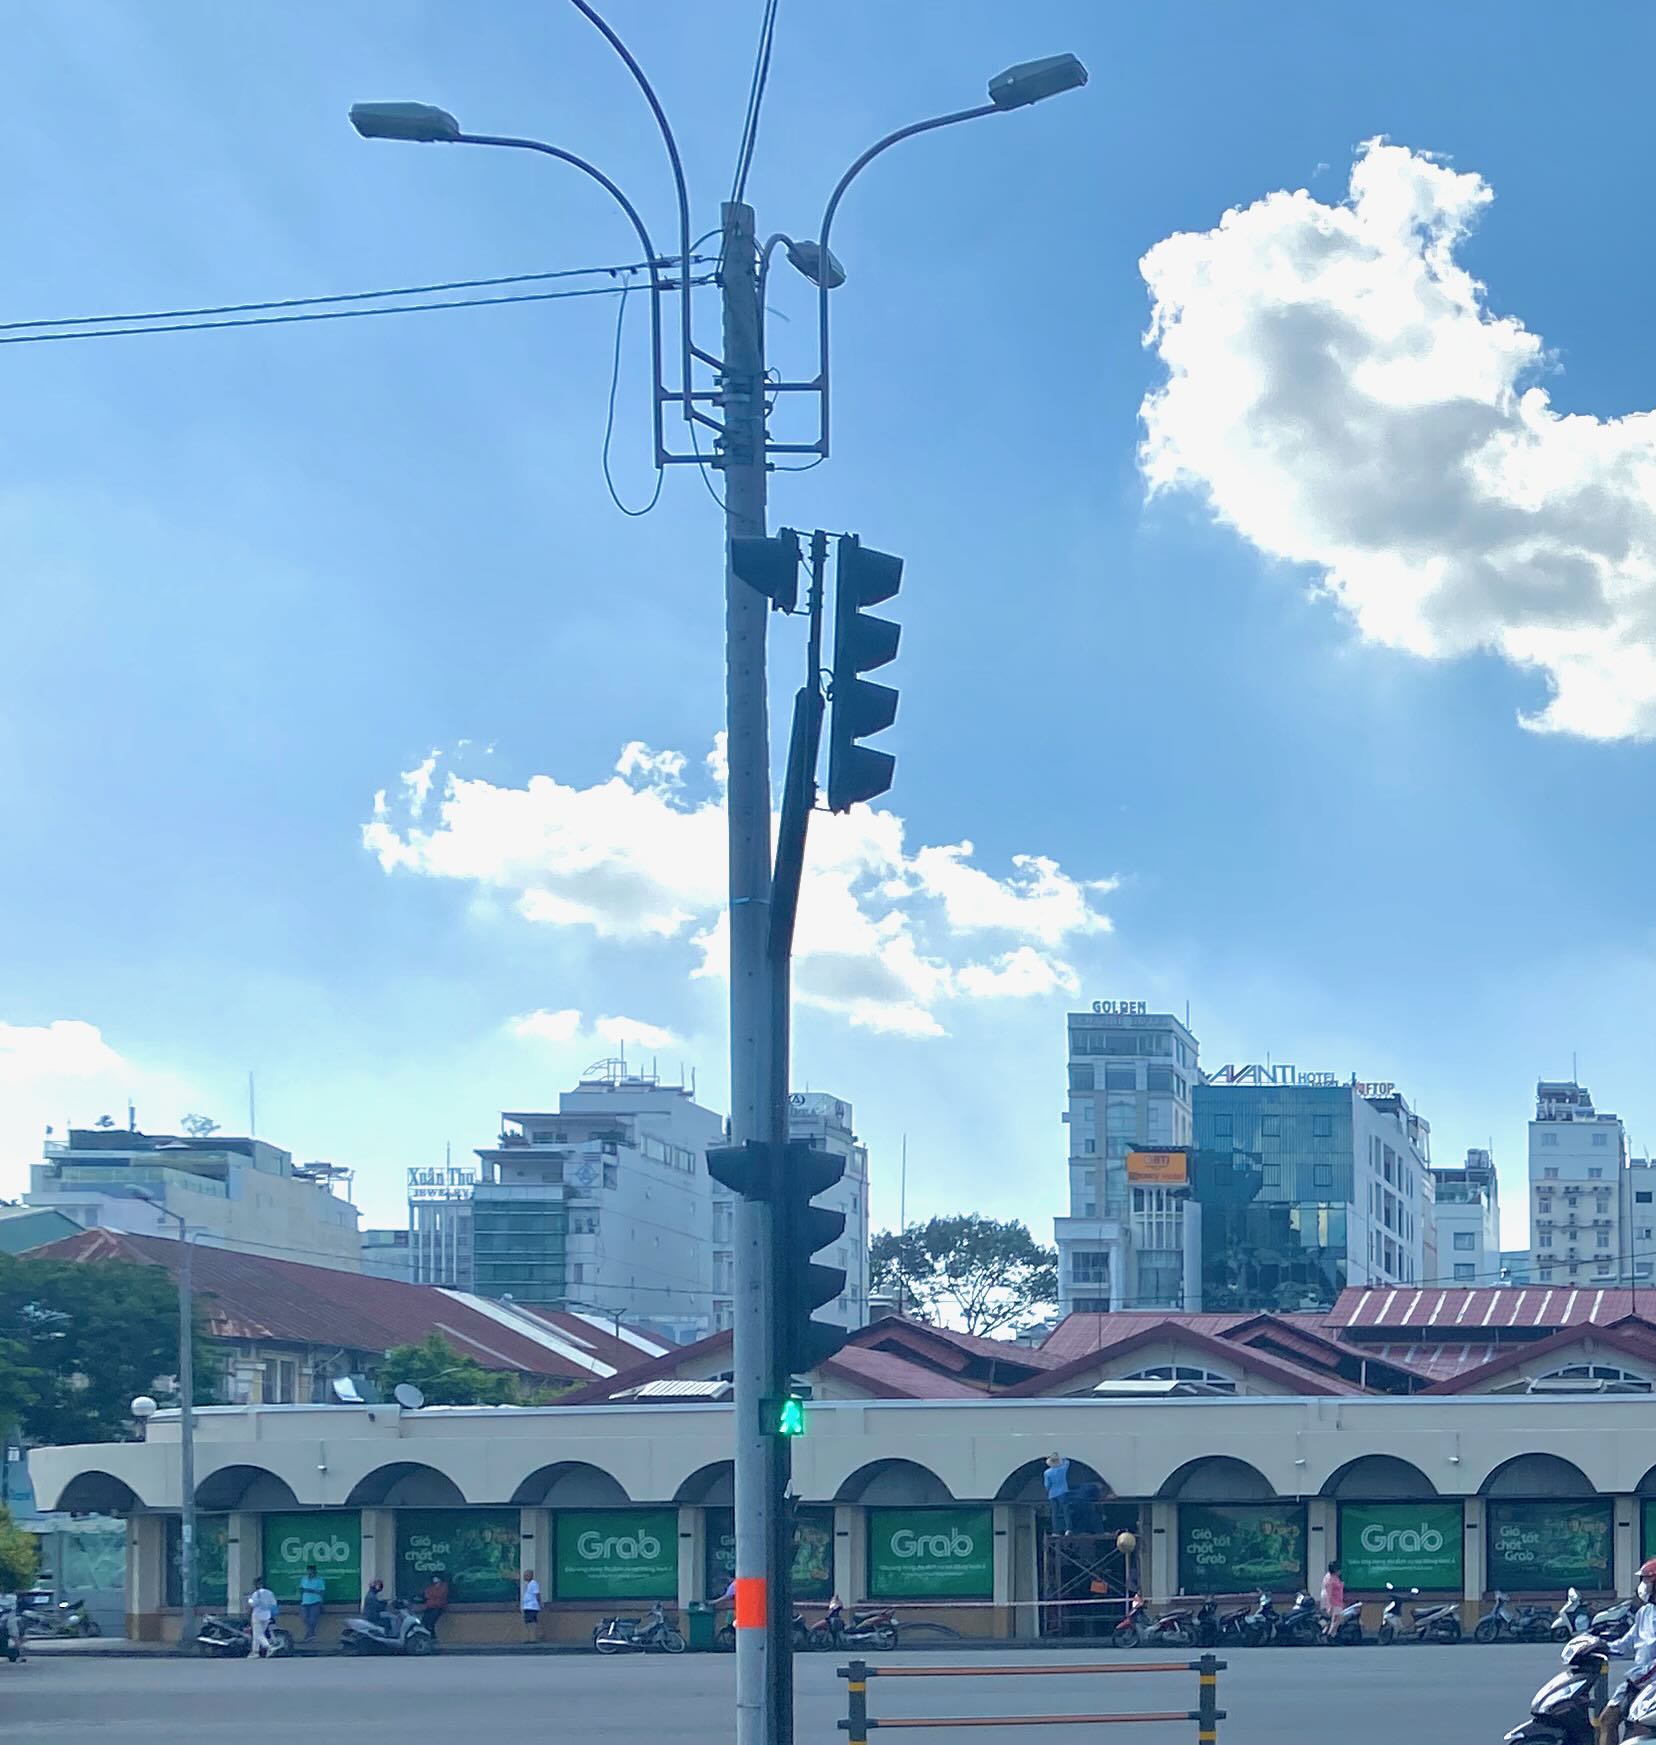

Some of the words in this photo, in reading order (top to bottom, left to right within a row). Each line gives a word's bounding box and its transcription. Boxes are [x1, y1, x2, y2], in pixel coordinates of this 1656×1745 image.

[1092, 1000, 1147, 1014] GOLDEN
[1210, 1064, 1296, 1083] AVANTI
[577, 1528, 661, 1560] Grab
[890, 1527, 974, 1558] Grab
[1360, 1522, 1444, 1553] Grab
[280, 1534, 350, 1563] Grab
[1504, 1550, 1535, 1561] Grab
[414, 1560, 446, 1572] Grab
[1196, 1553, 1227, 1565] Grab
